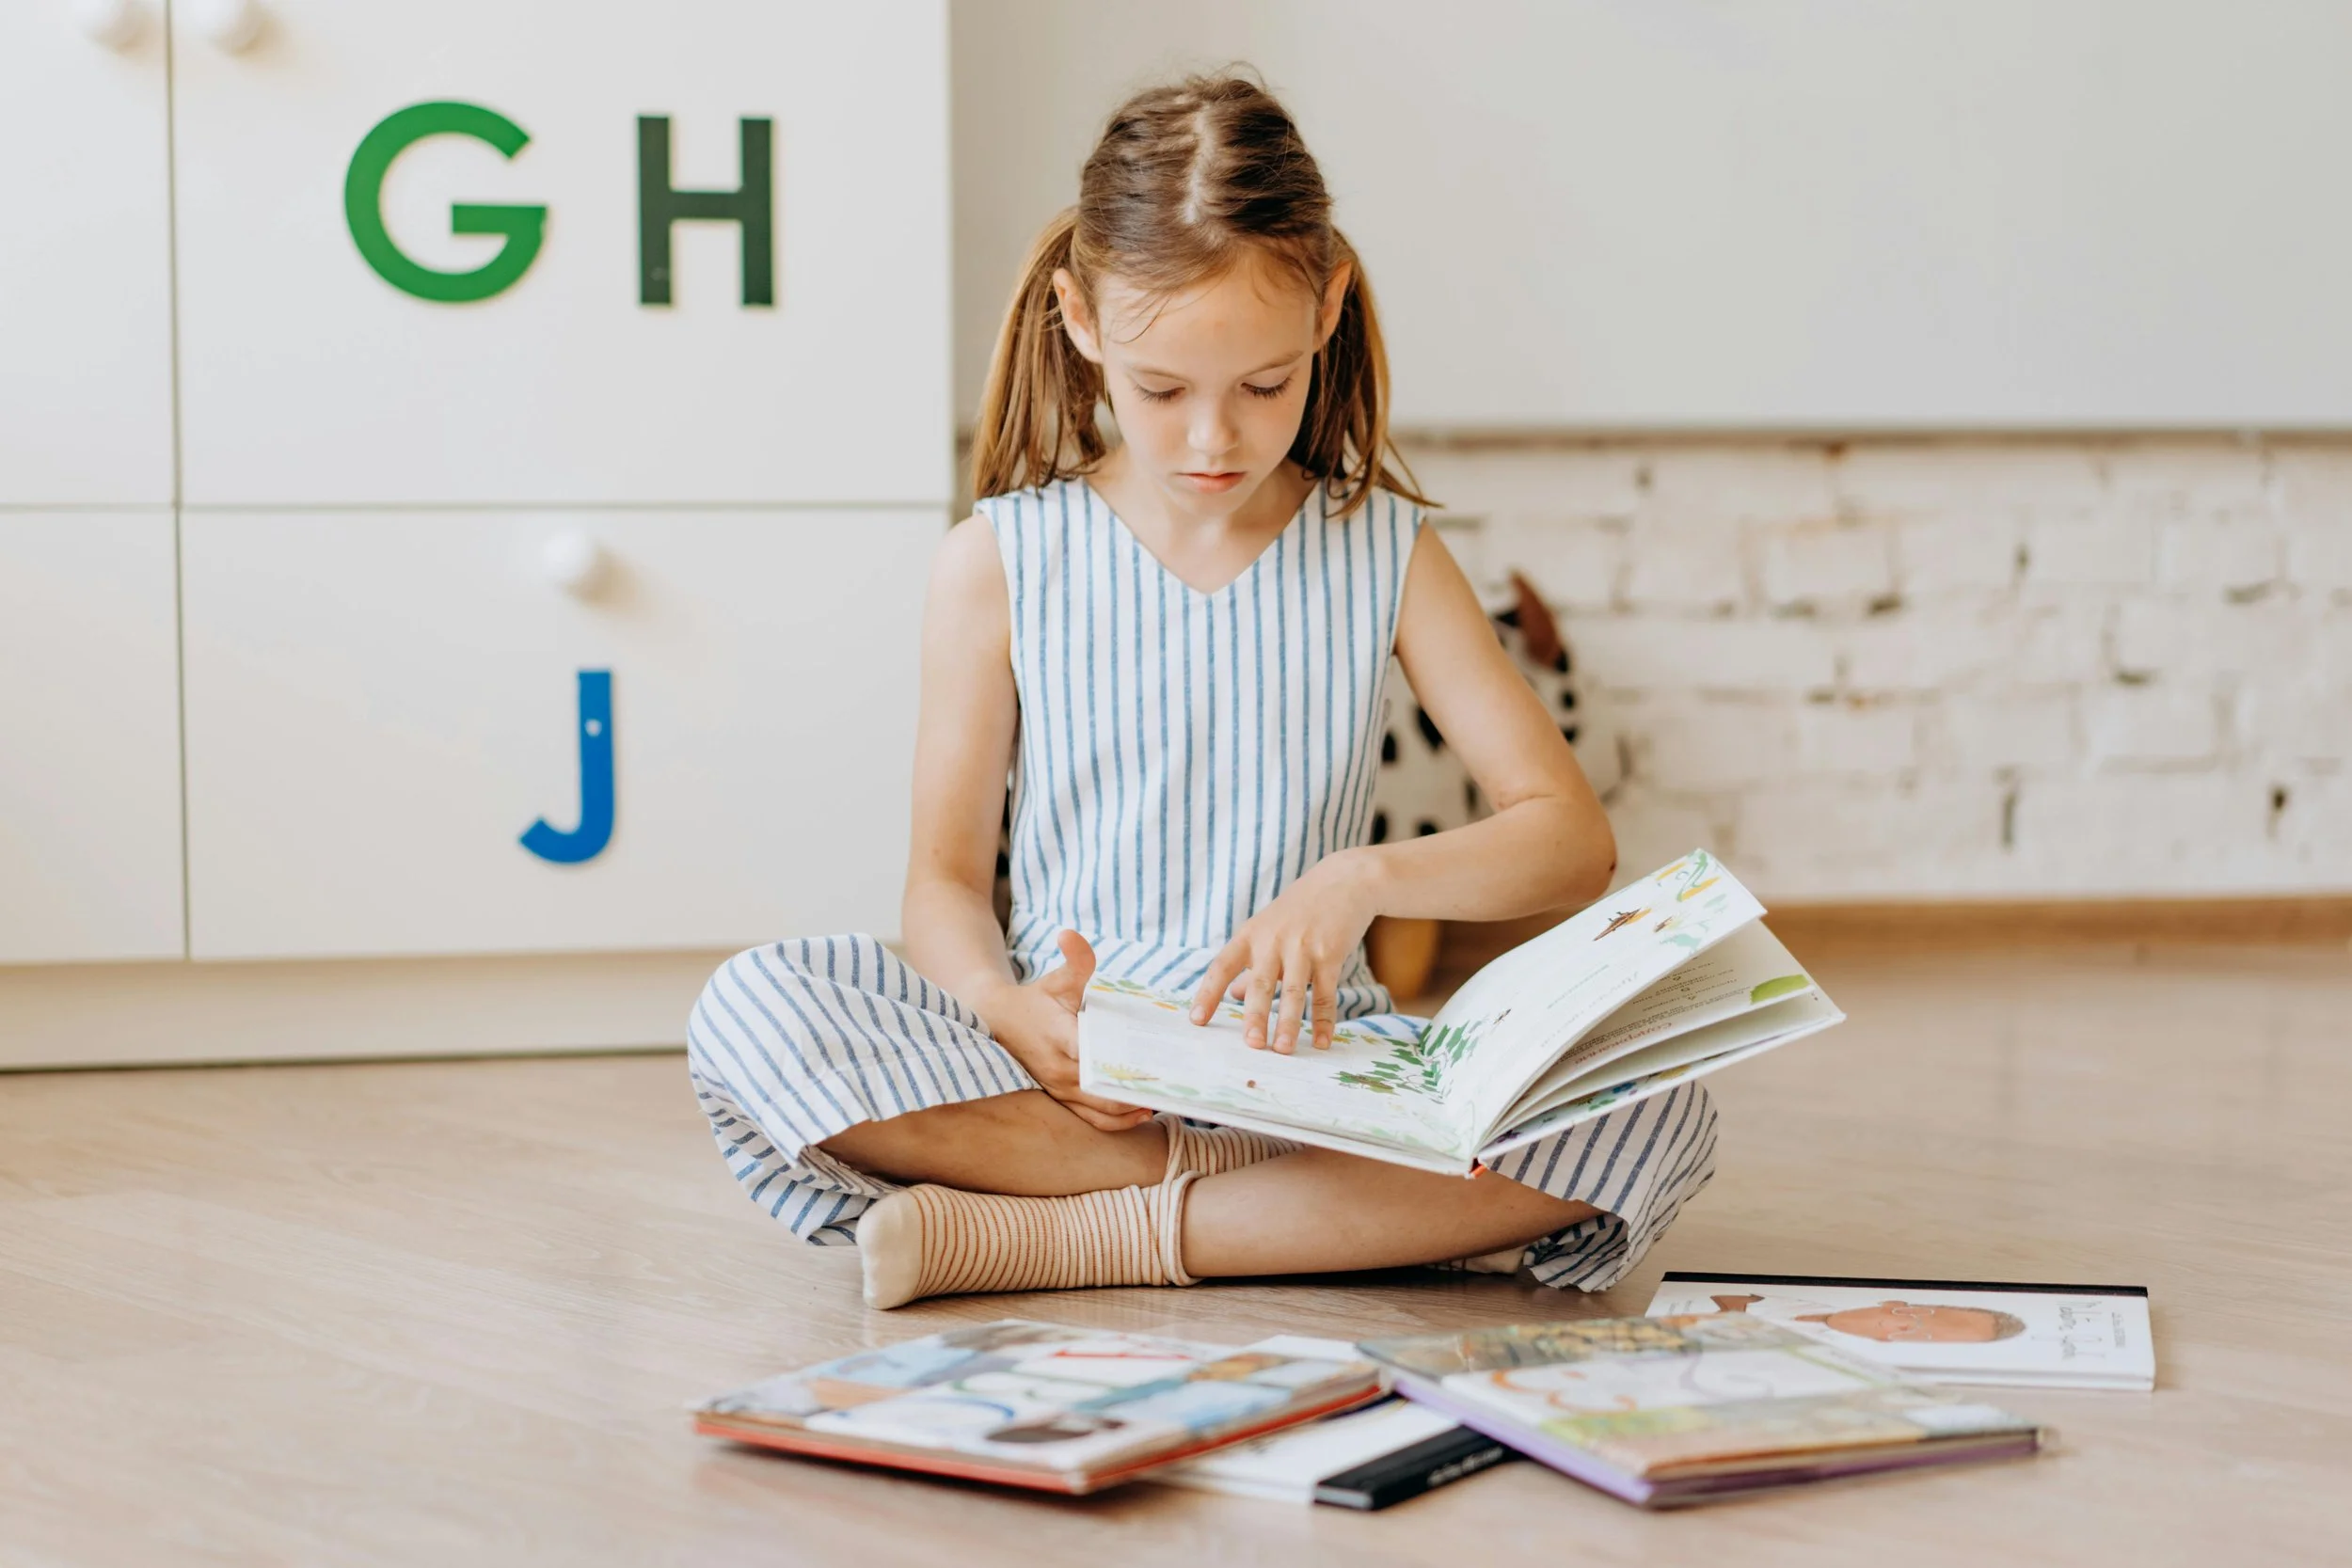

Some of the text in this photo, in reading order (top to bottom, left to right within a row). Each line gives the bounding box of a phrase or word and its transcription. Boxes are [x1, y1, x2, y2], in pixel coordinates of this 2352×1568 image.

[344, 101, 774, 307] G H
[518, 670, 614, 863] J
